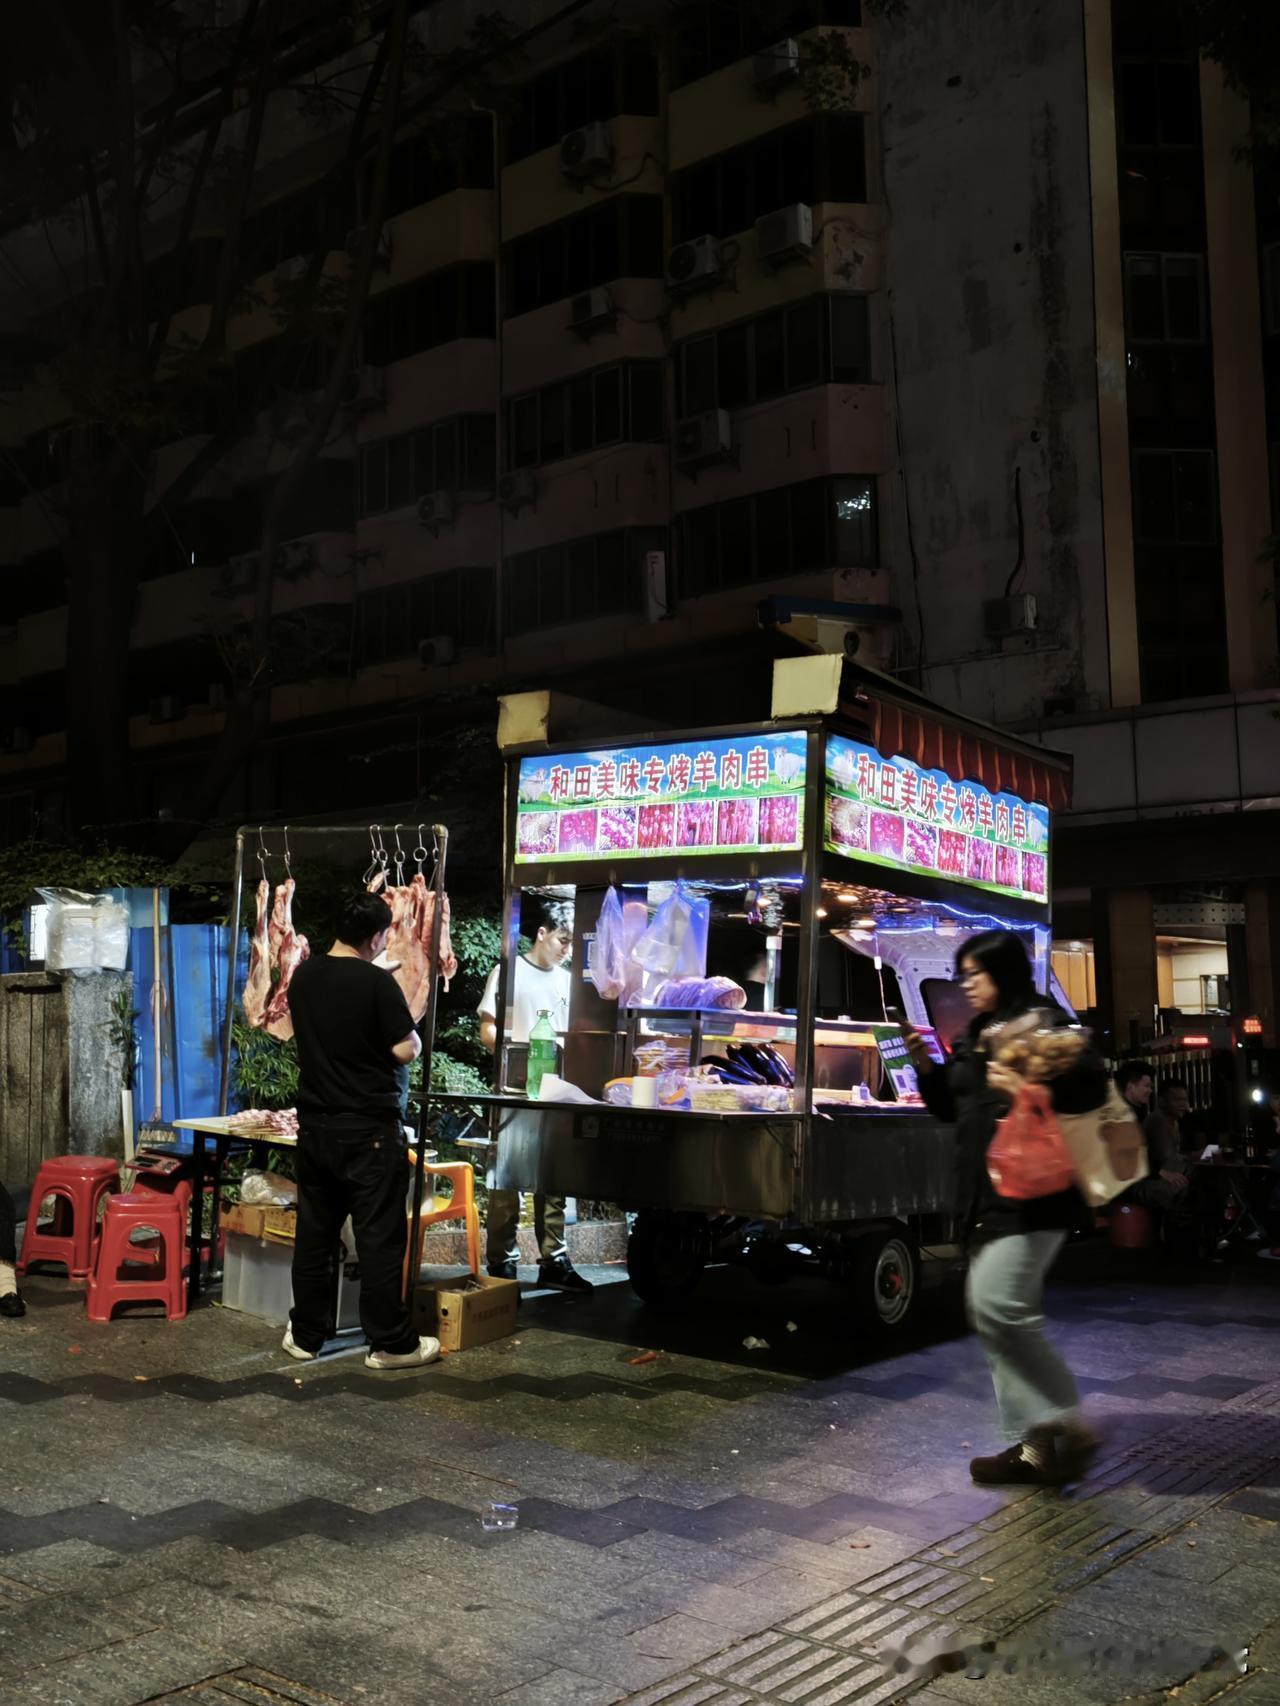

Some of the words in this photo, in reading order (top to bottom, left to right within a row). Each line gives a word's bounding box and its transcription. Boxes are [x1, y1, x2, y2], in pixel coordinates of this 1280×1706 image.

[550, 746, 769, 800] 和田美味专烤羊肉串
[857, 753, 1026, 845] 和田美味专烤羊肉串
